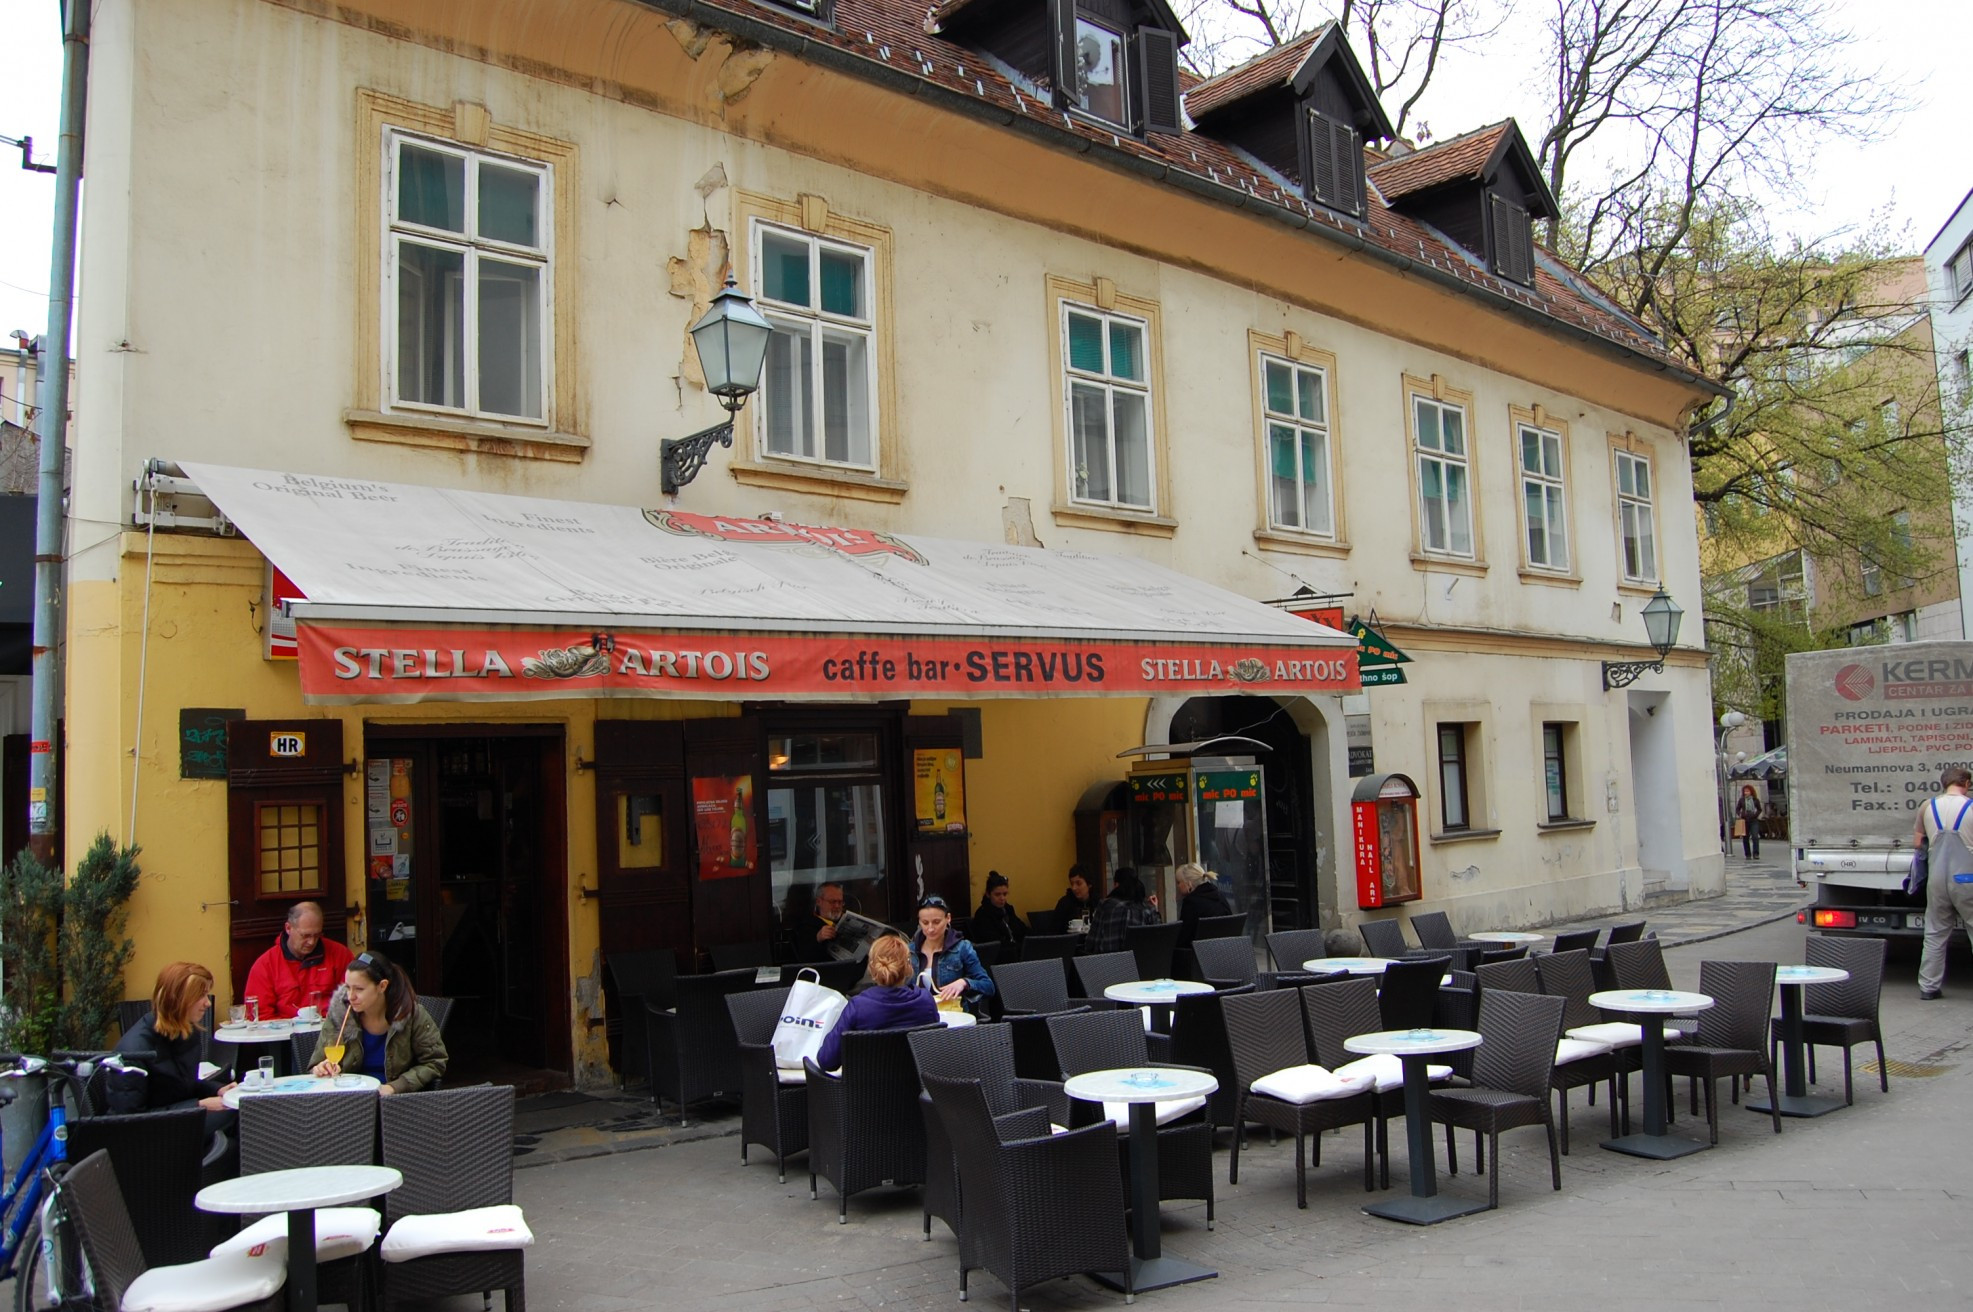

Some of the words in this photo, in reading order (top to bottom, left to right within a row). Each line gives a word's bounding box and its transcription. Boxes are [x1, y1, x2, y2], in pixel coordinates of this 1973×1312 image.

[253, 482, 344, 499] Original
[350, 491, 399, 503] Beer
[481, 513, 596, 534] Ingredients
[521, 513, 582, 525] Finest
[333, 647, 514, 680] STELLA
[618, 649, 771, 681] ARTOIS
[823, 651, 896, 683] caffe
[1140, 658, 1225, 681] STELLA
[1274, 659, 1348, 682] ARTOIS
[1381, 671, 1398, 682] šop
[1888, 685, 1944, 697] CENTAR
[1949, 684, 1967, 694] ZA
[1834, 708, 1916, 721] PRODAJA
[1920, 708, 1925, 717] I
[1820, 723, 1894, 735] PARKETI,
[1897, 723, 1941, 732] PODNE
[1945, 723, 1949, 731] I
[277, 737, 299, 753] HR
[1844, 735, 1907, 745] LAMINATI,
[1868, 745, 1923, 754] LJEPILA,
[1925, 743, 1951, 752] PVC
[1824, 763, 1914, 774] Neumannova
[1917, 762, 1931, 773] 3,
[1850, 782, 1892, 794] Tel.:
[1851, 799, 1899, 811] Fax.:
[1356, 806, 1366, 866] MANIKURA
[1366, 844, 1374, 874] NAIL
[1368, 882, 1376, 904] ART
[780, 1015, 825, 1029] oint
